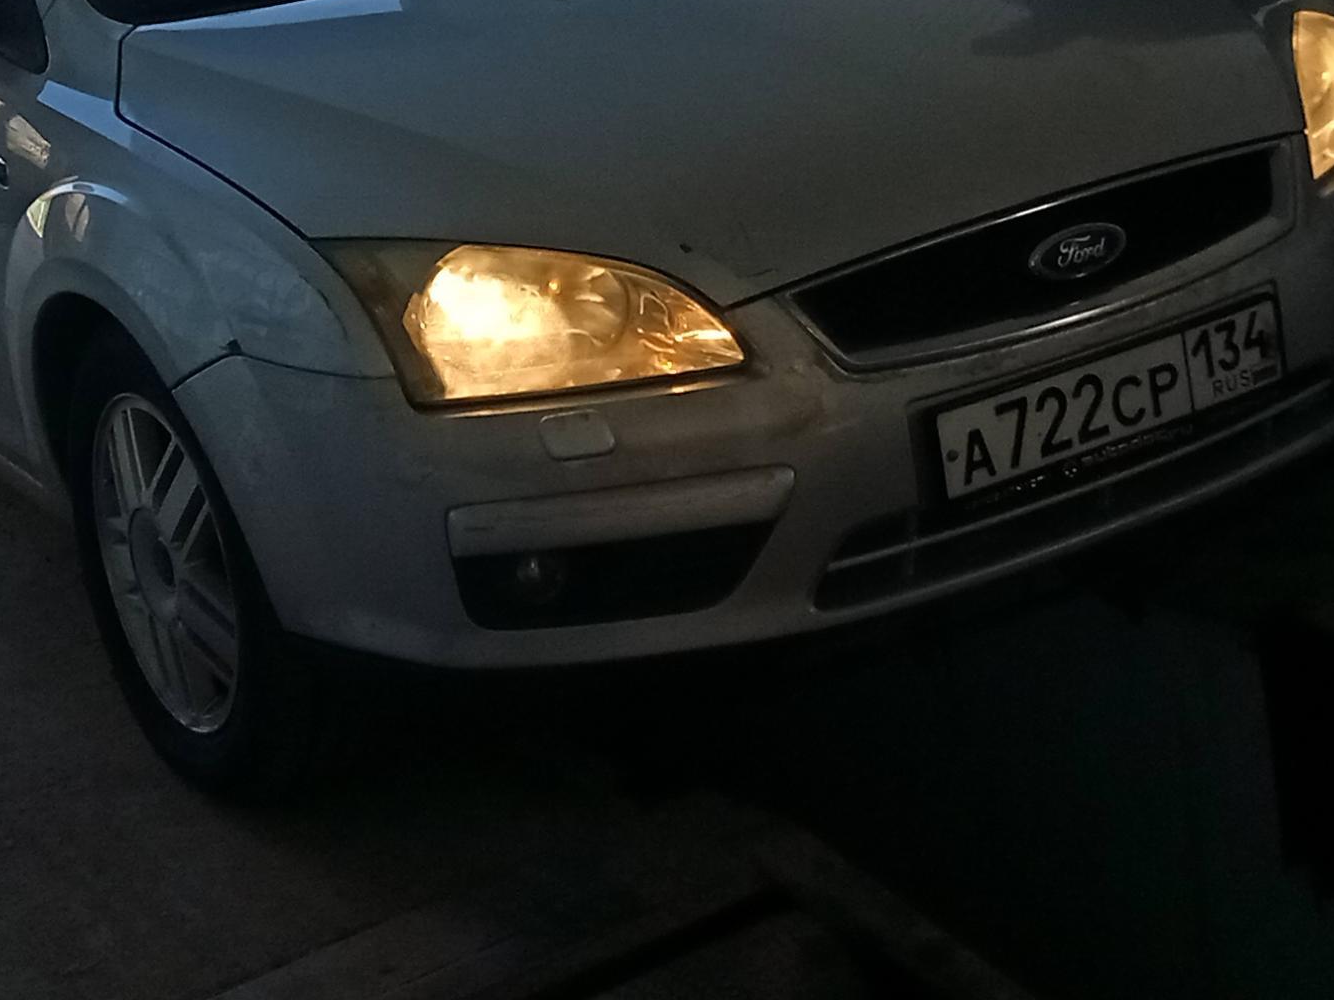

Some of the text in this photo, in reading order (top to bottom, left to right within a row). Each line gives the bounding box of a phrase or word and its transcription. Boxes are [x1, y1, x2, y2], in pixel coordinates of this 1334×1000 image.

[1058, 235, 1105, 268] Ford
[1192, 311, 1267, 378] 134
[1212, 370, 1249, 397] RUS
